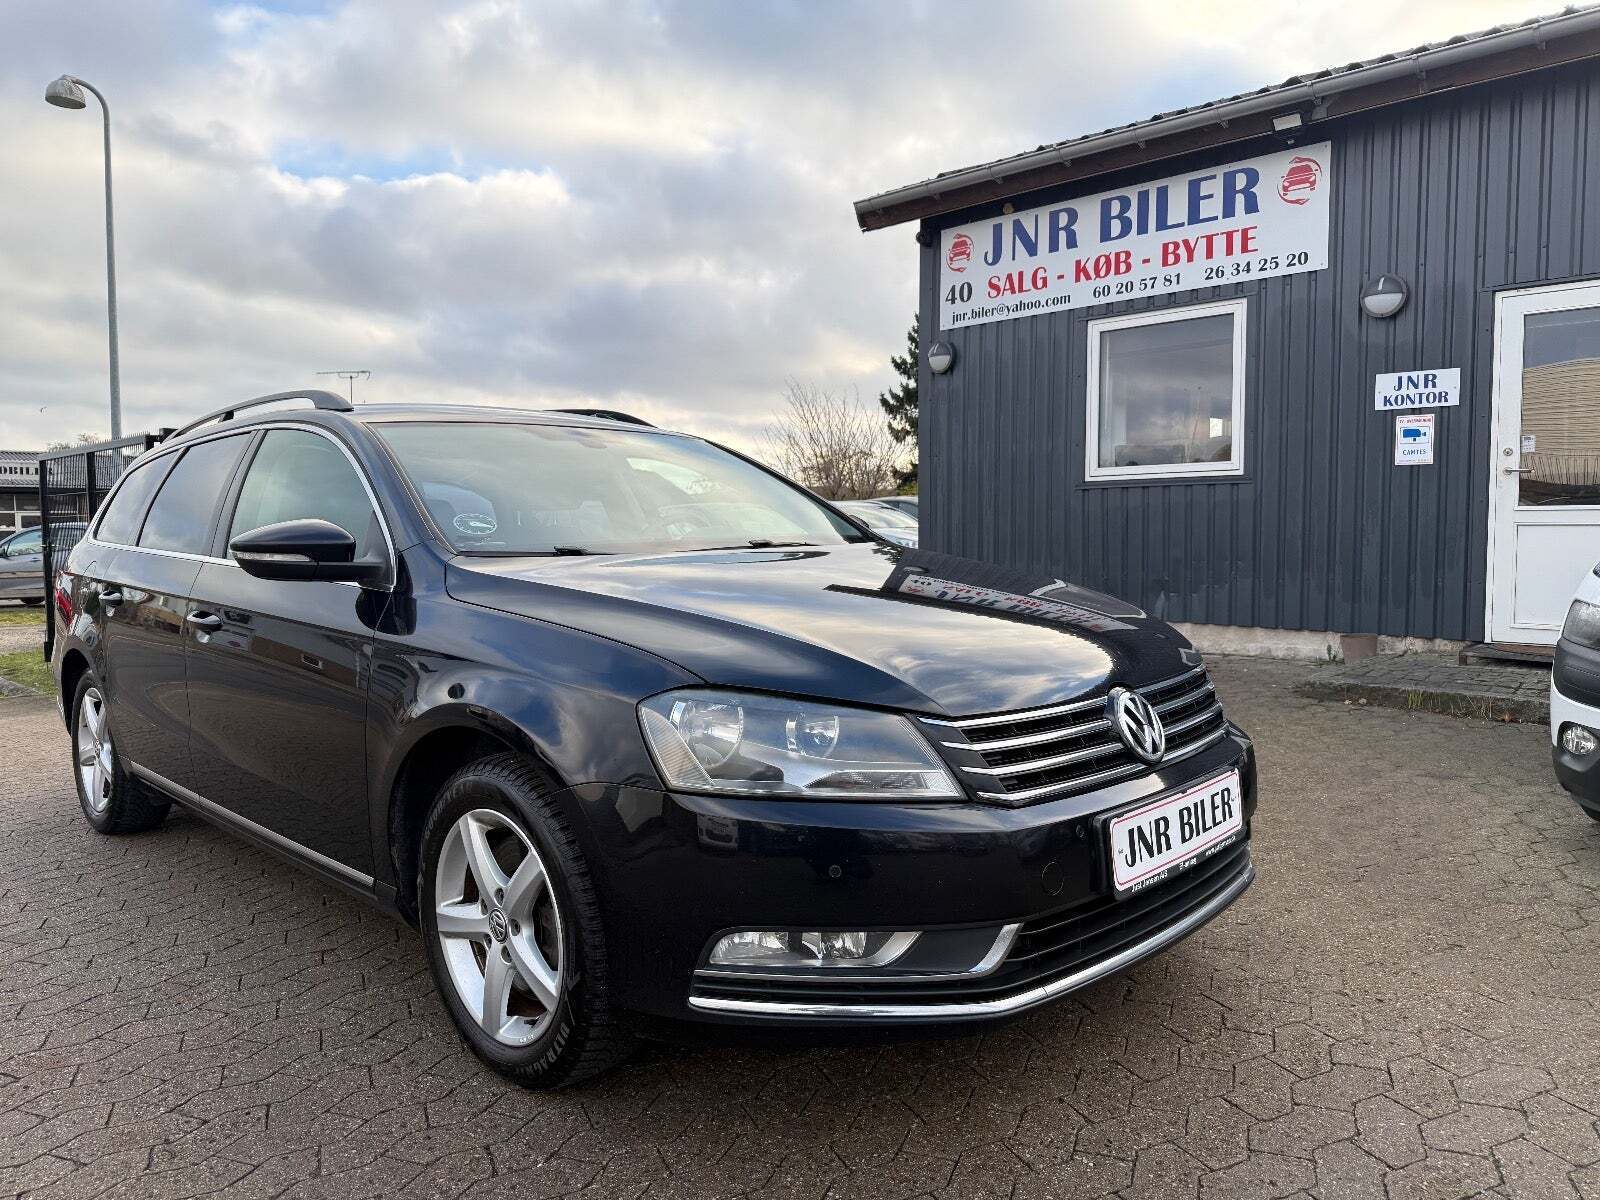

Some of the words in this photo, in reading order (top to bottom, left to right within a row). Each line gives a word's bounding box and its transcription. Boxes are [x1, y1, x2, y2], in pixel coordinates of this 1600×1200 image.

[984, 207, 1078, 266] JNR
[1100, 167, 1260, 243] BILER
[988, 266, 1048, 299] SALG
[1074, 250, 1132, 283] KØB
[1161, 225, 1259, 268] BYTTE
[1204, 265, 1225, 281] 26
[1231, 260, 1251, 276] 34
[1258, 255, 1279, 273] 25
[1286, 251, 1309, 268] 20
[945, 281, 973, 305] 40
[1092, 284, 1111, 299] 60
[1115, 280, 1134, 295] 20
[1138, 276, 1157, 291] 57
[1163, 272, 1181, 287] 81
[952, 294, 1071, 325] jnr.biler@yahoo.com
[1393, 373, 1438, 392] JNR
[1383, 391, 1449, 407] KONTOR
[1125, 816, 1172, 868] JNR
[1178, 787, 1234, 844] BILER
